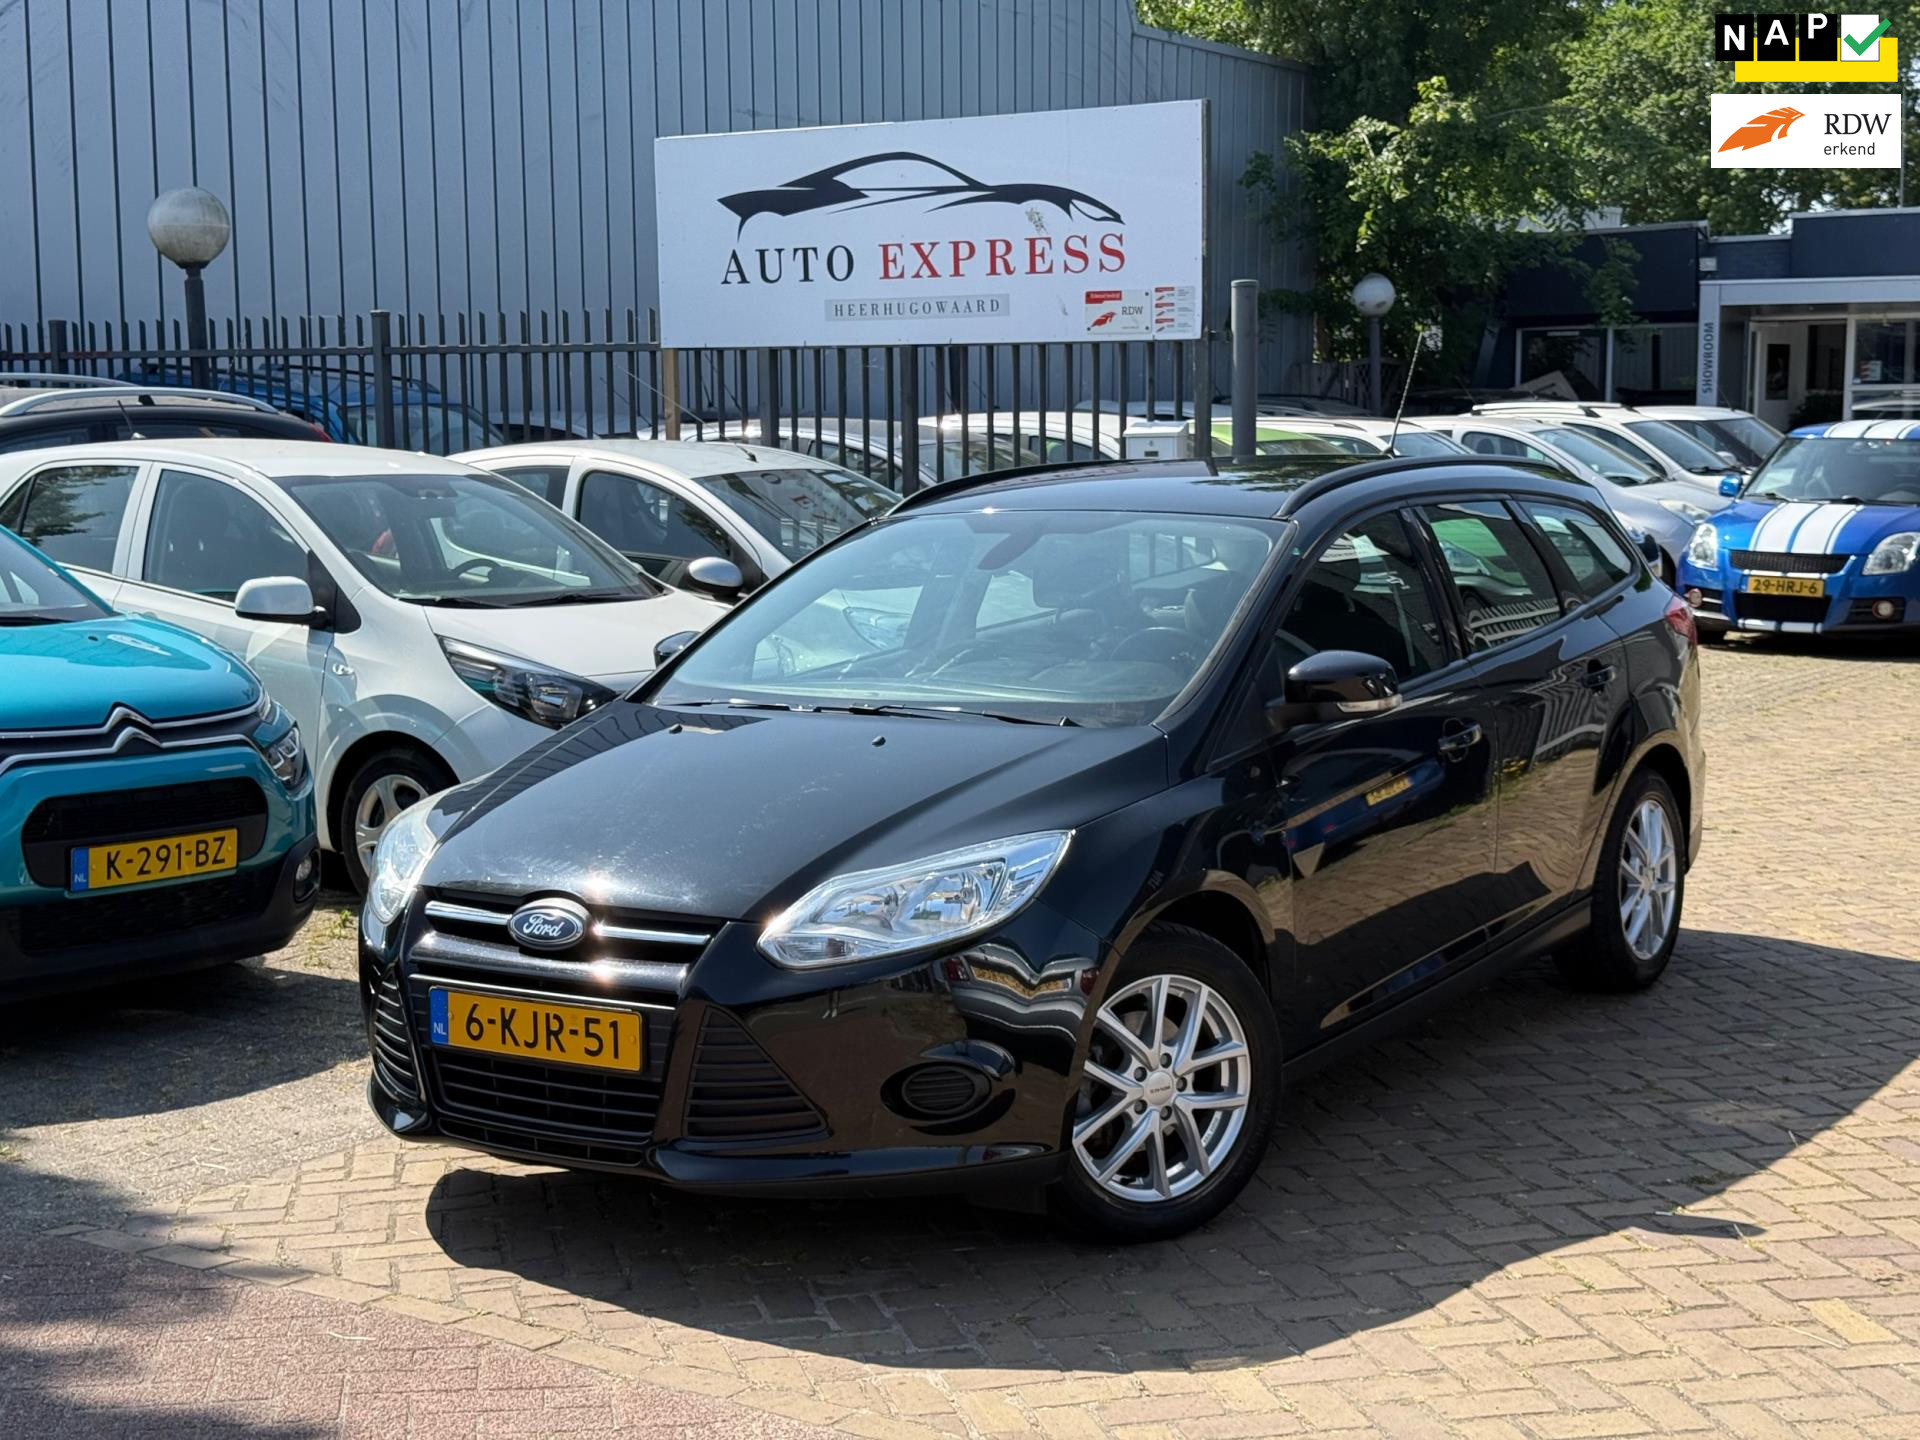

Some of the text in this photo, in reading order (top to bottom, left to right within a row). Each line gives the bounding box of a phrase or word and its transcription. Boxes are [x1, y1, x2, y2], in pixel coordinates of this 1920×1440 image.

[721, 233, 1126, 284] AUTO EXPRESS
[834, 299, 1000, 317] HEERHUGOWAARD
[1121, 306, 1144, 316] RDW
[1702, 322, 1714, 394] SHOWROOM
[1752, 579, 1817, 594] 29-HRJ-6
[74, 836, 227, 883] NL K-291-BZ
[522, 913, 565, 937] Ford
[433, 1003, 620, 1060] NL 6-KJR-51
